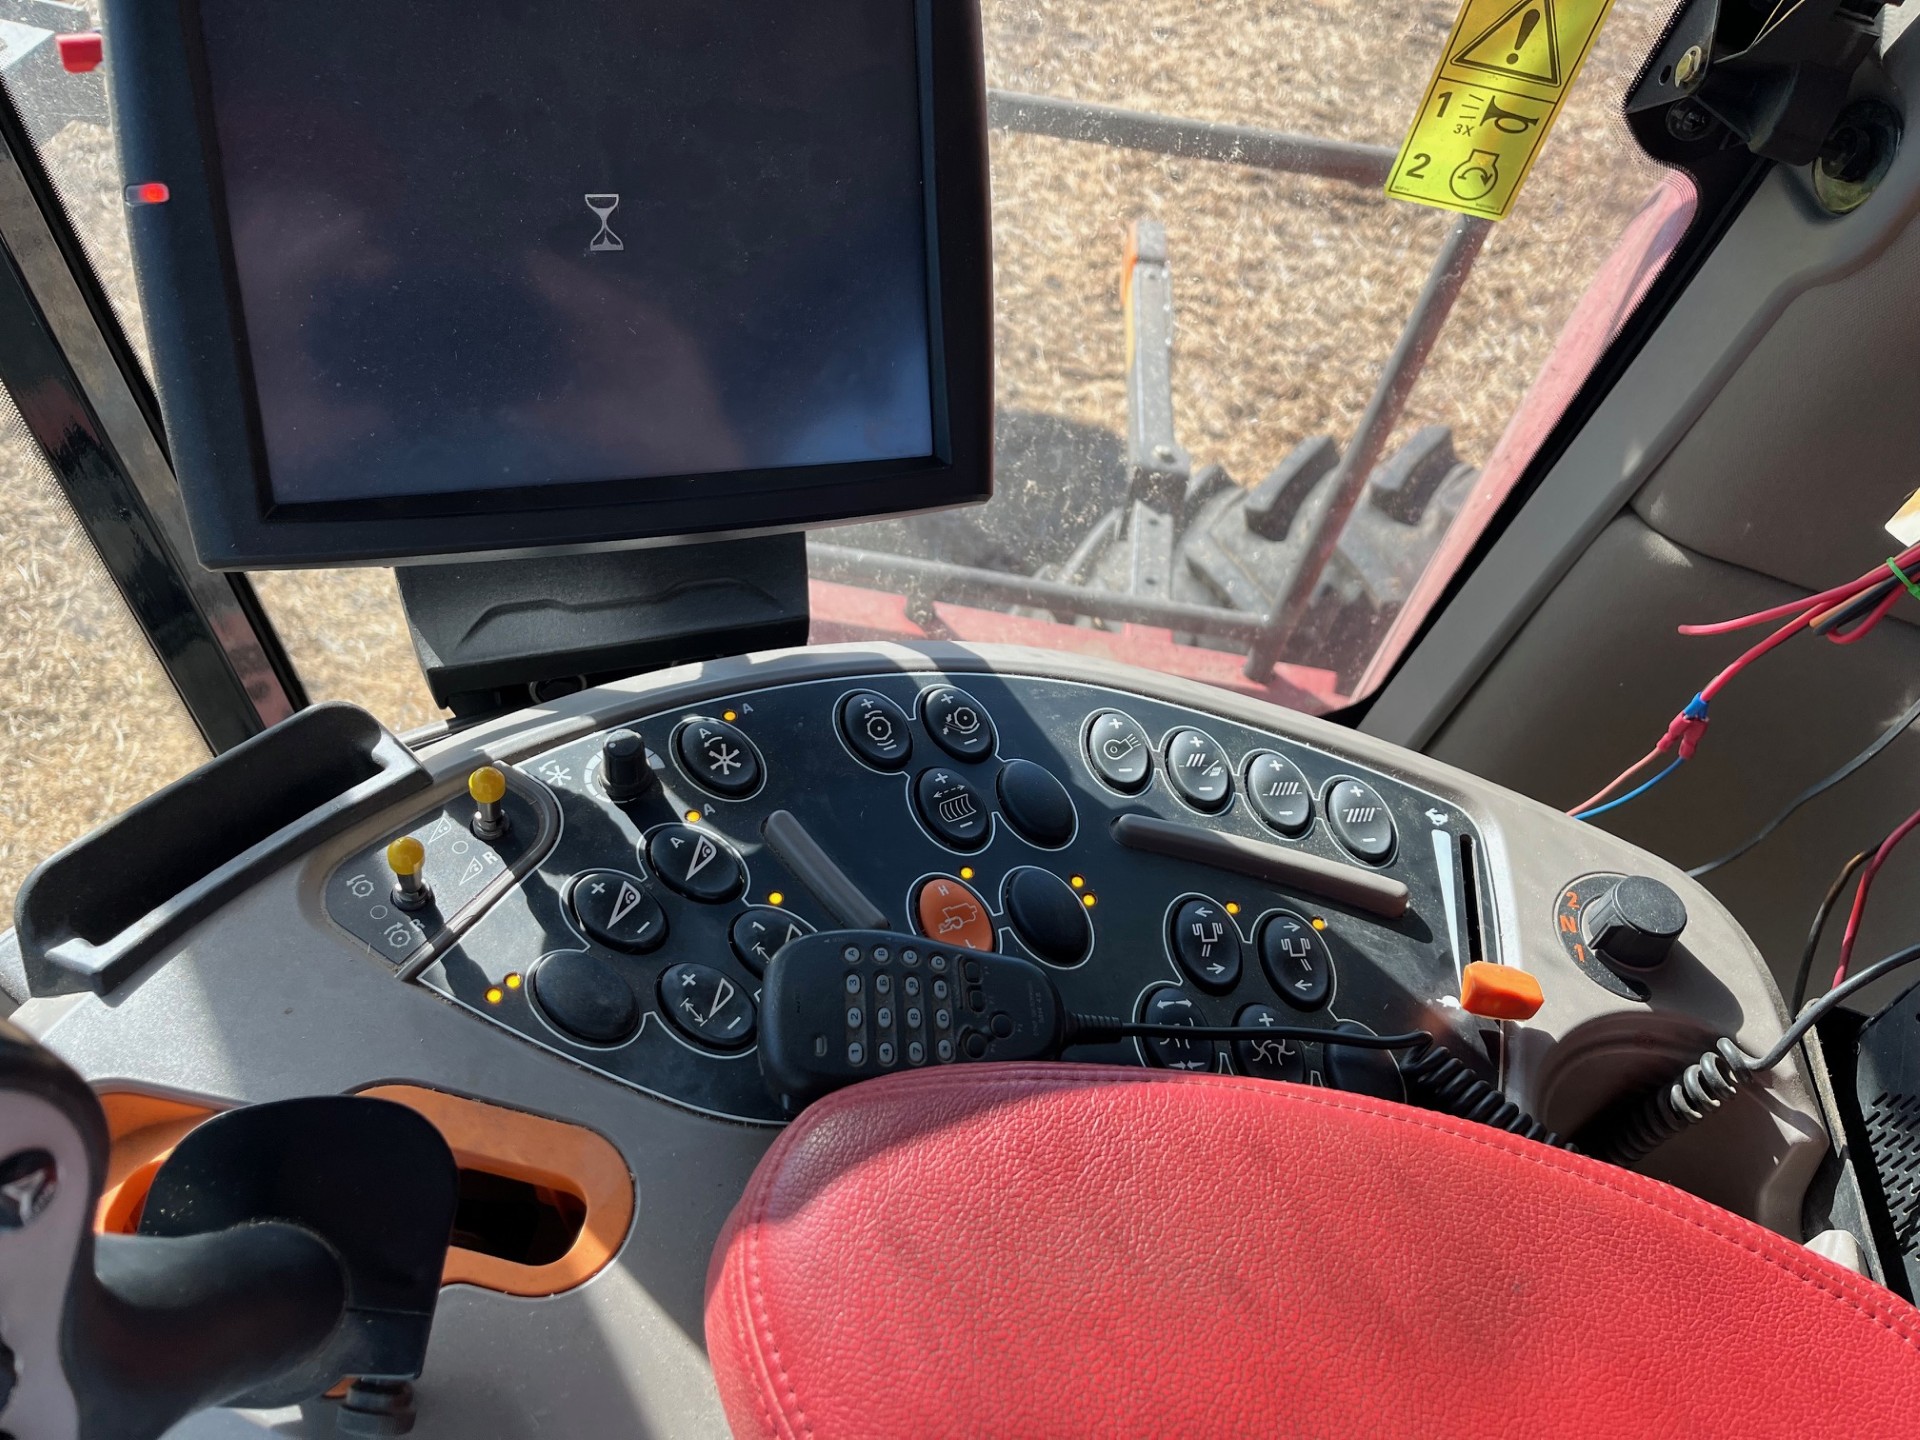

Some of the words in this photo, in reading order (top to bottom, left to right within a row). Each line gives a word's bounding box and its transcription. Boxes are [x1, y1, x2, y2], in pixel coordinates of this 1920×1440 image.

[1436, 91, 1453, 117] 1
[1453, 124, 1475, 137] 3X
[1405, 152, 1431, 179] 2
[742, 702, 754, 714] A
[698, 728, 712, 739] A
[703, 803, 716, 816] A
[670, 836, 685, 849] A
[482, 851, 499, 865] R
[937, 884, 950, 896] H
[1566, 891, 1580, 909] 2
[409, 918, 426, 932] R
[1559, 915, 1577, 933] N
[1573, 943, 1585, 963] 1
[850, 1012, 859, 1020] 2
[882, 1048, 890, 1056] 4
[912, 1047, 921, 1055] 7
